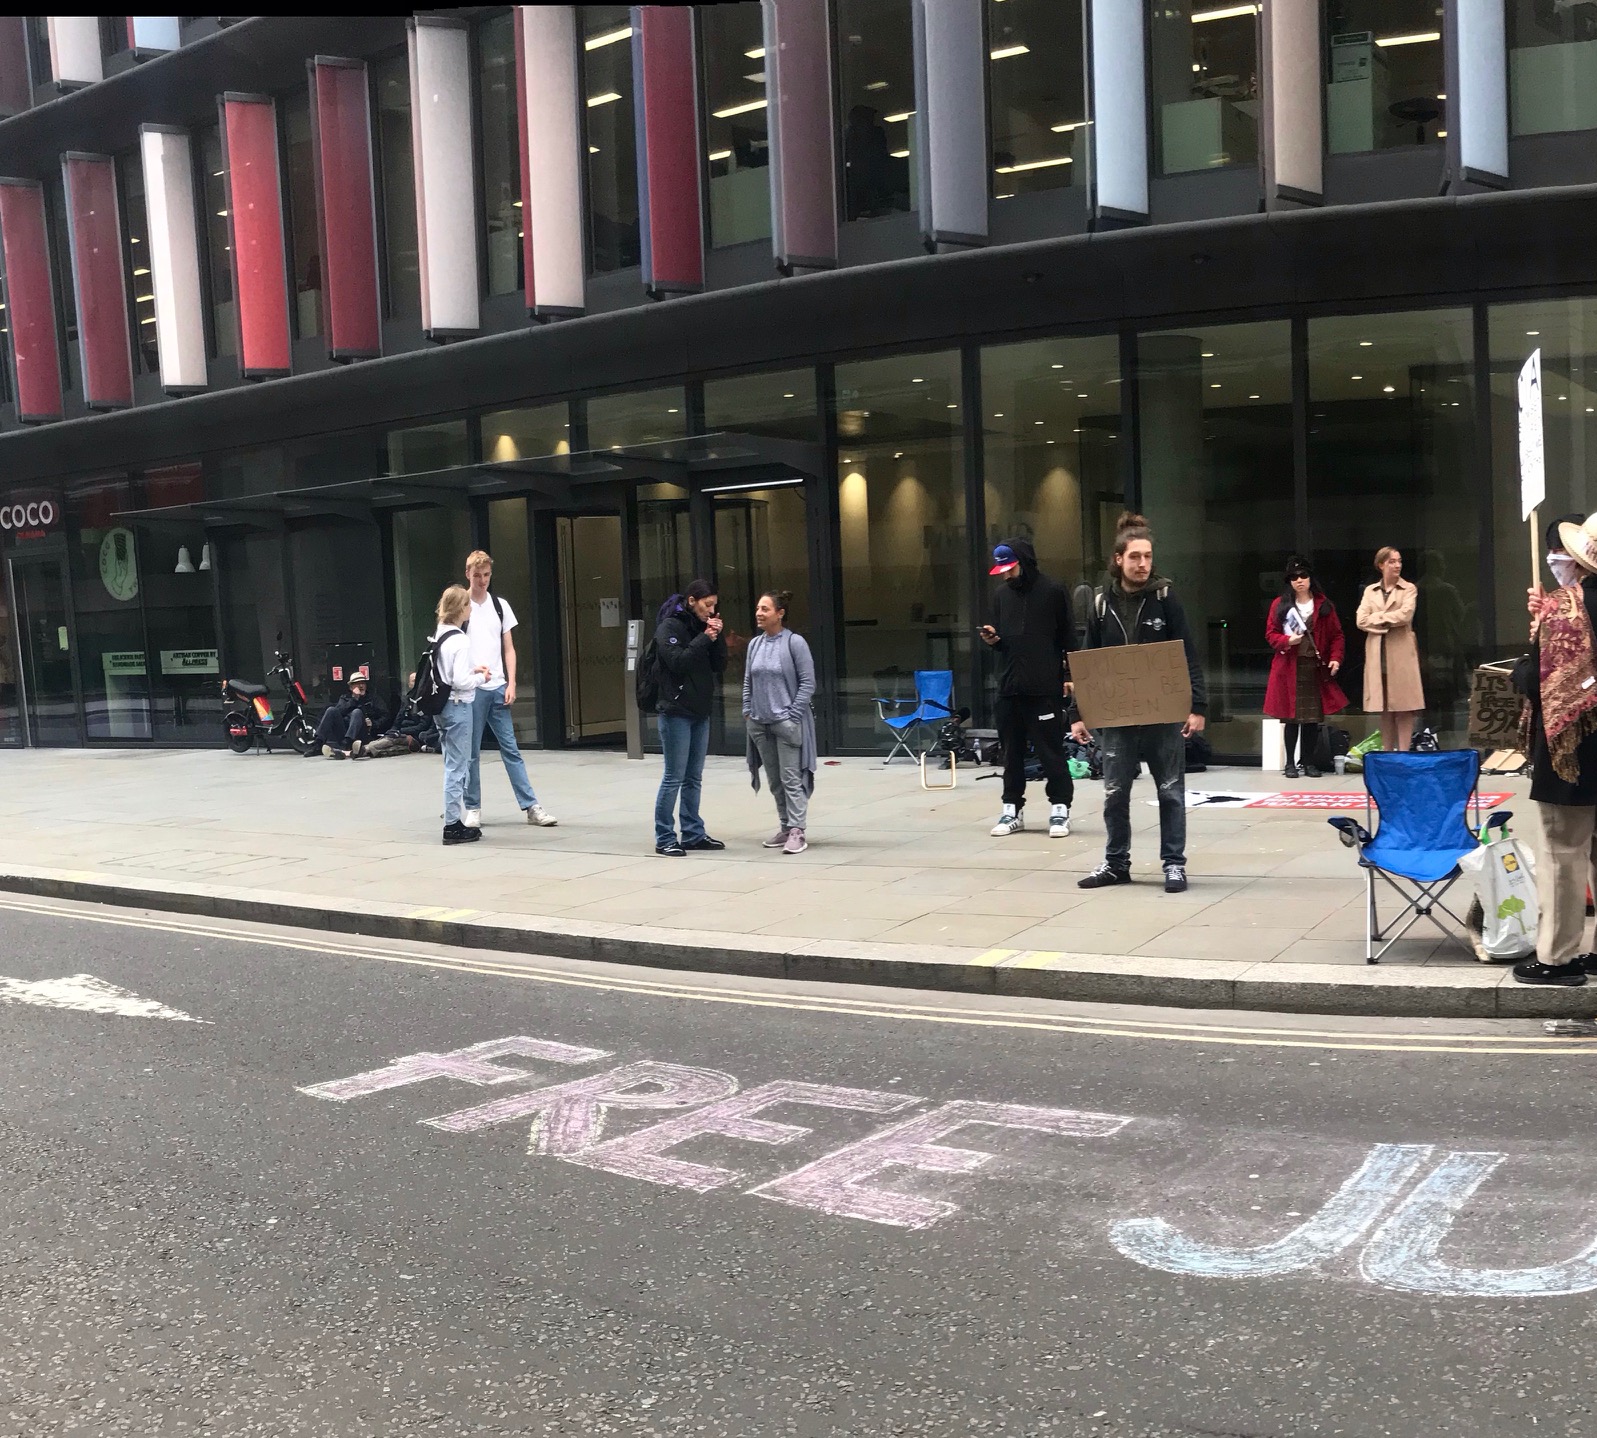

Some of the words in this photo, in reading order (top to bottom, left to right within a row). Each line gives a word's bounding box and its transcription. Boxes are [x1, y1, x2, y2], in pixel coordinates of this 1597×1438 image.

[0, 501, 54, 530] COCO
[1102, 697, 1160, 721] SEEN
[293, 1033, 1133, 1233] FREE
